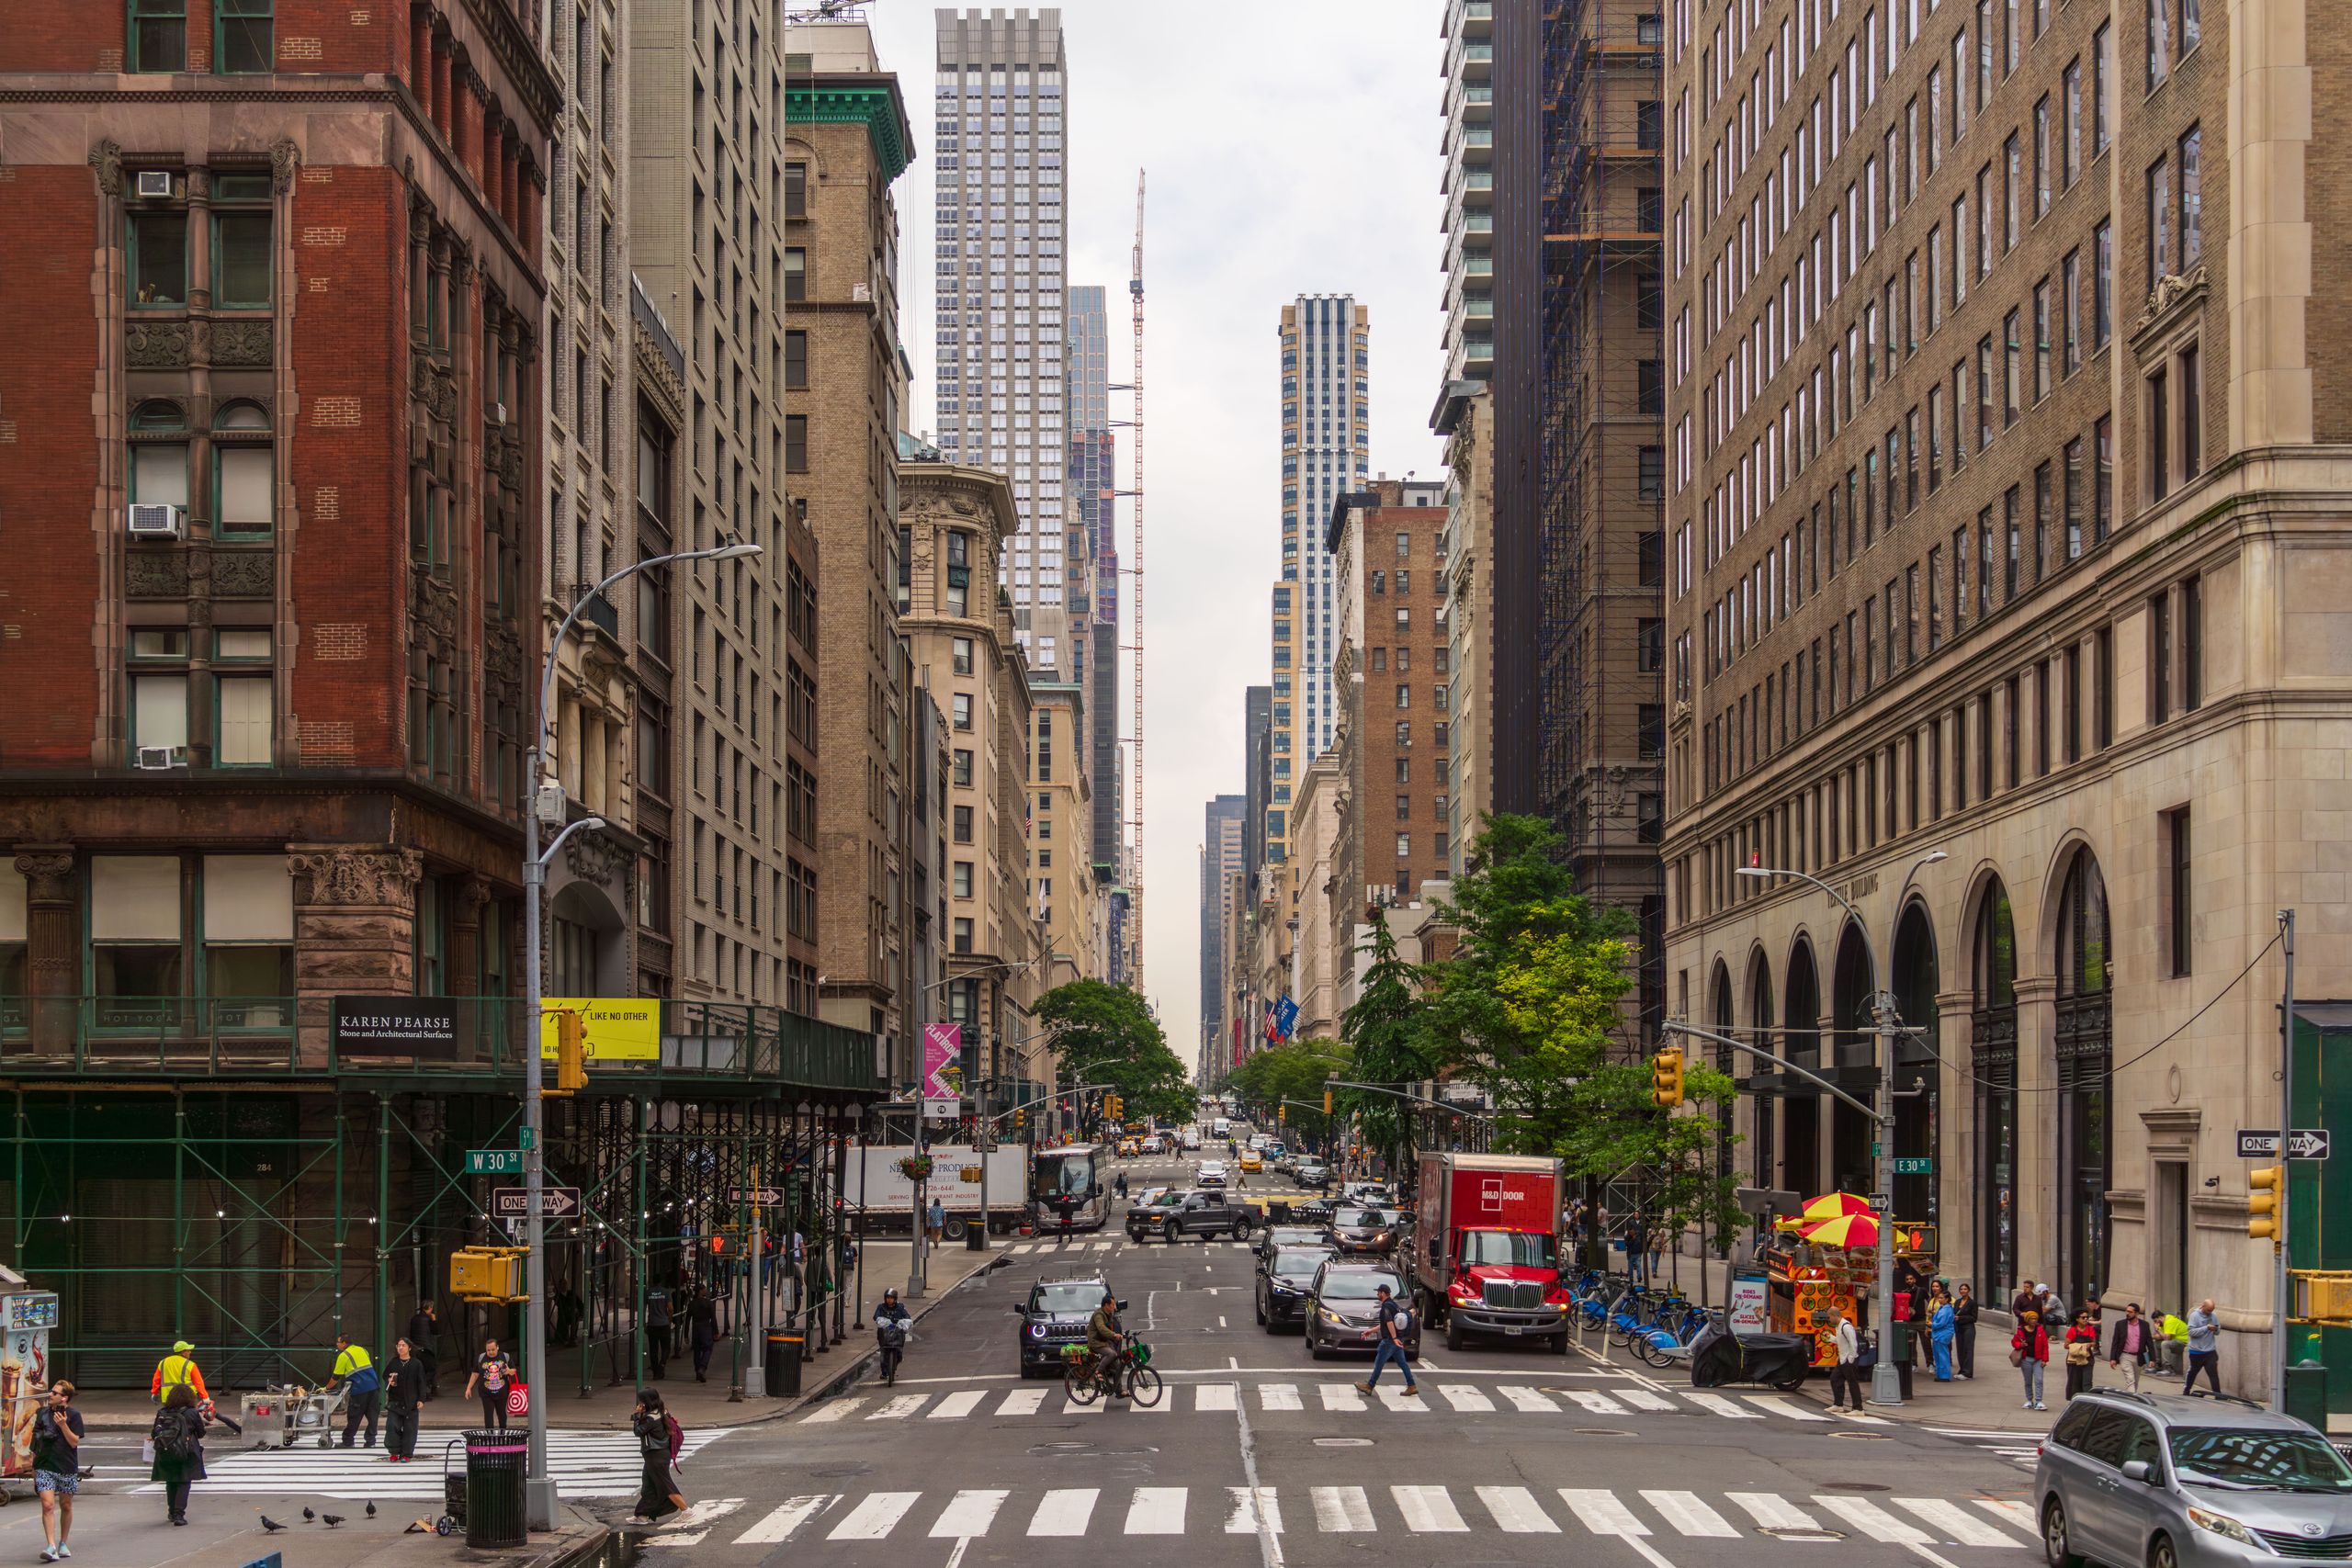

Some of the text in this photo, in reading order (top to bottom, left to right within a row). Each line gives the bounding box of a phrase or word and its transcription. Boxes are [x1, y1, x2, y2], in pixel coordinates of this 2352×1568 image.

[1850, 873, 1879, 901] BUILDING
[103, 1015, 129, 1023] HOT
[590, 1011, 607, 1021] LIKE
[609, 1012, 621, 1021] NO
[623, 1012, 649, 1021] OTHER
[340, 1016, 450, 1029] KAREN PEARSE
[340, 1029, 360, 1037] Stone
[376, 1030, 423, 1038] Architectural
[423, 1030, 453, 1039] Surfaces
[925, 1023, 961, 1058] FLATIRON
[929, 1072, 956, 1098] NOMAD
[2245, 1138, 2316, 1150] ONE WAY
[473, 1152, 517, 1169] W 30 St
[1899, 1160, 1905, 1171] E
[1906, 1160, 1917, 1171] 30
[256, 1163, 272, 1172] 284
[736, 1191, 775, 1201] OE WAY
[1481, 1190, 1524, 1201] M&D DOOR
[503, 1197, 565, 1209] ONE WAY
